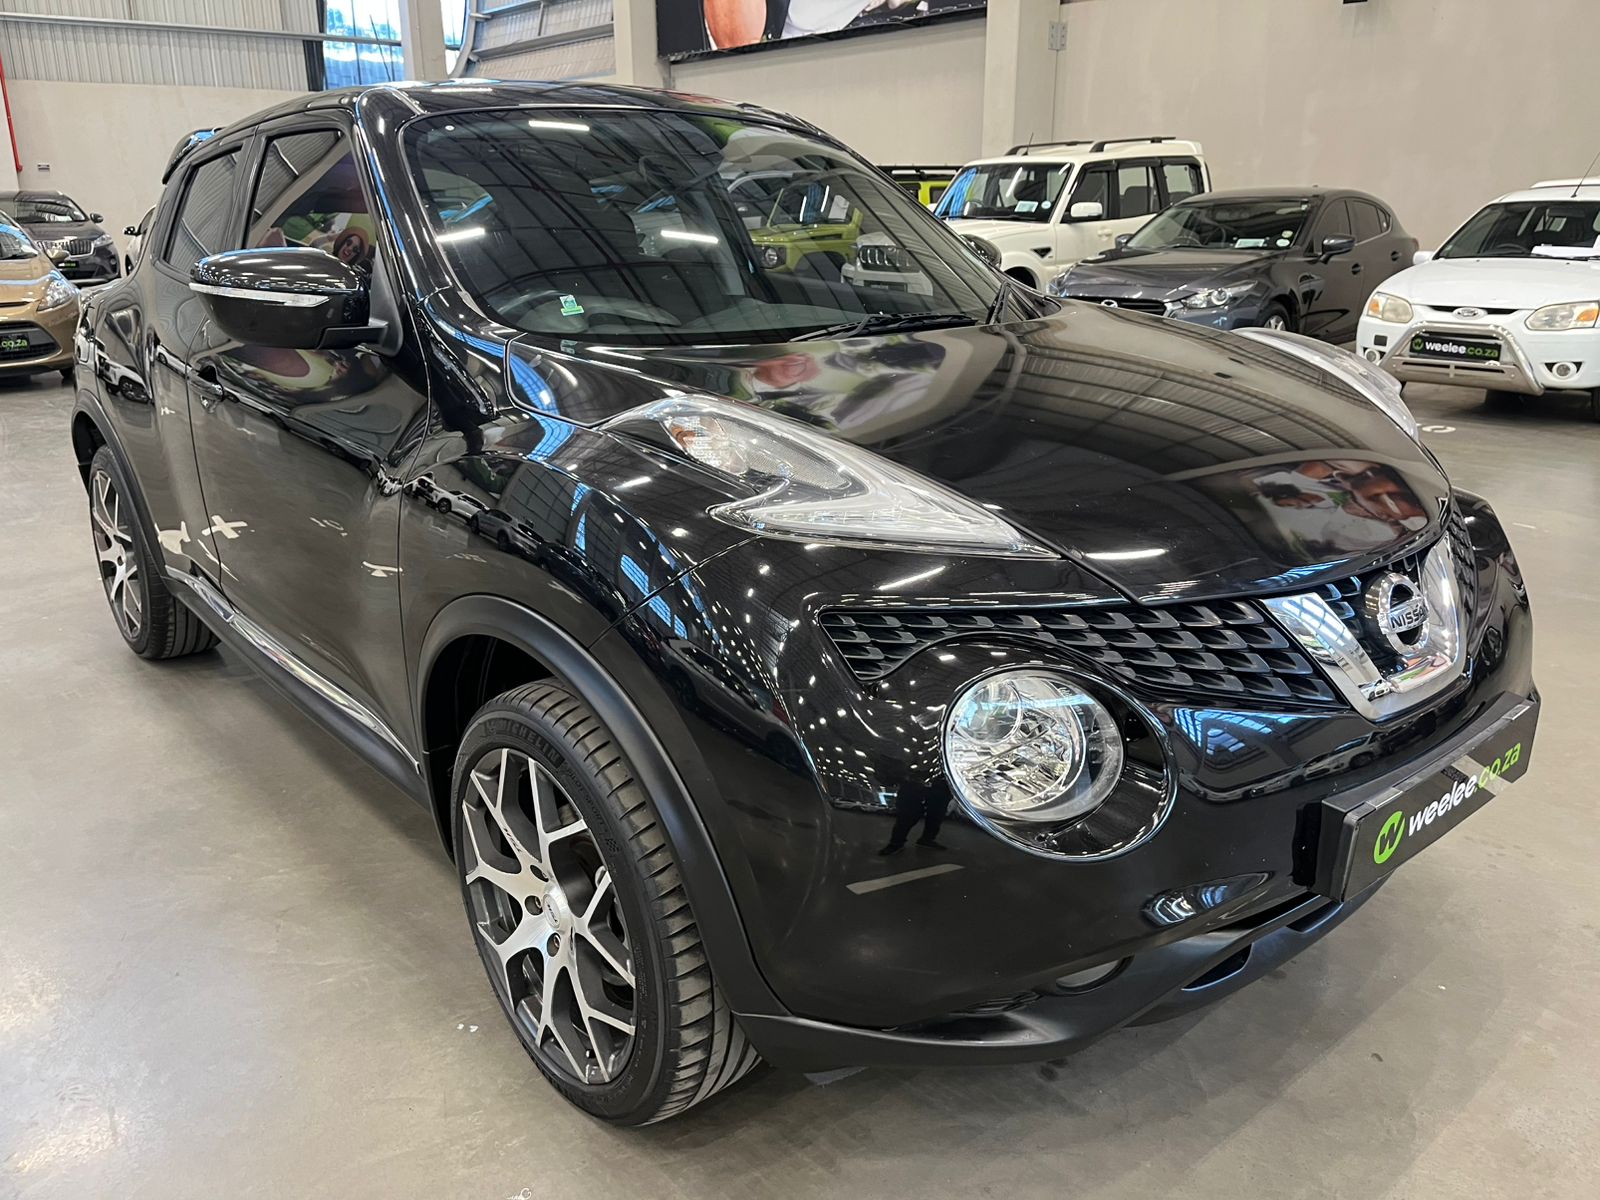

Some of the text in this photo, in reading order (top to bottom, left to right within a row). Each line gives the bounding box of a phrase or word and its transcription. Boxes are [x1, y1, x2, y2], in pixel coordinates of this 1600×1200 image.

[1425, 341, 1499, 358] weelee.co.za
[496, 719, 562, 764] MICHELIN
[1408, 742, 1521, 836] weelee.co.za
